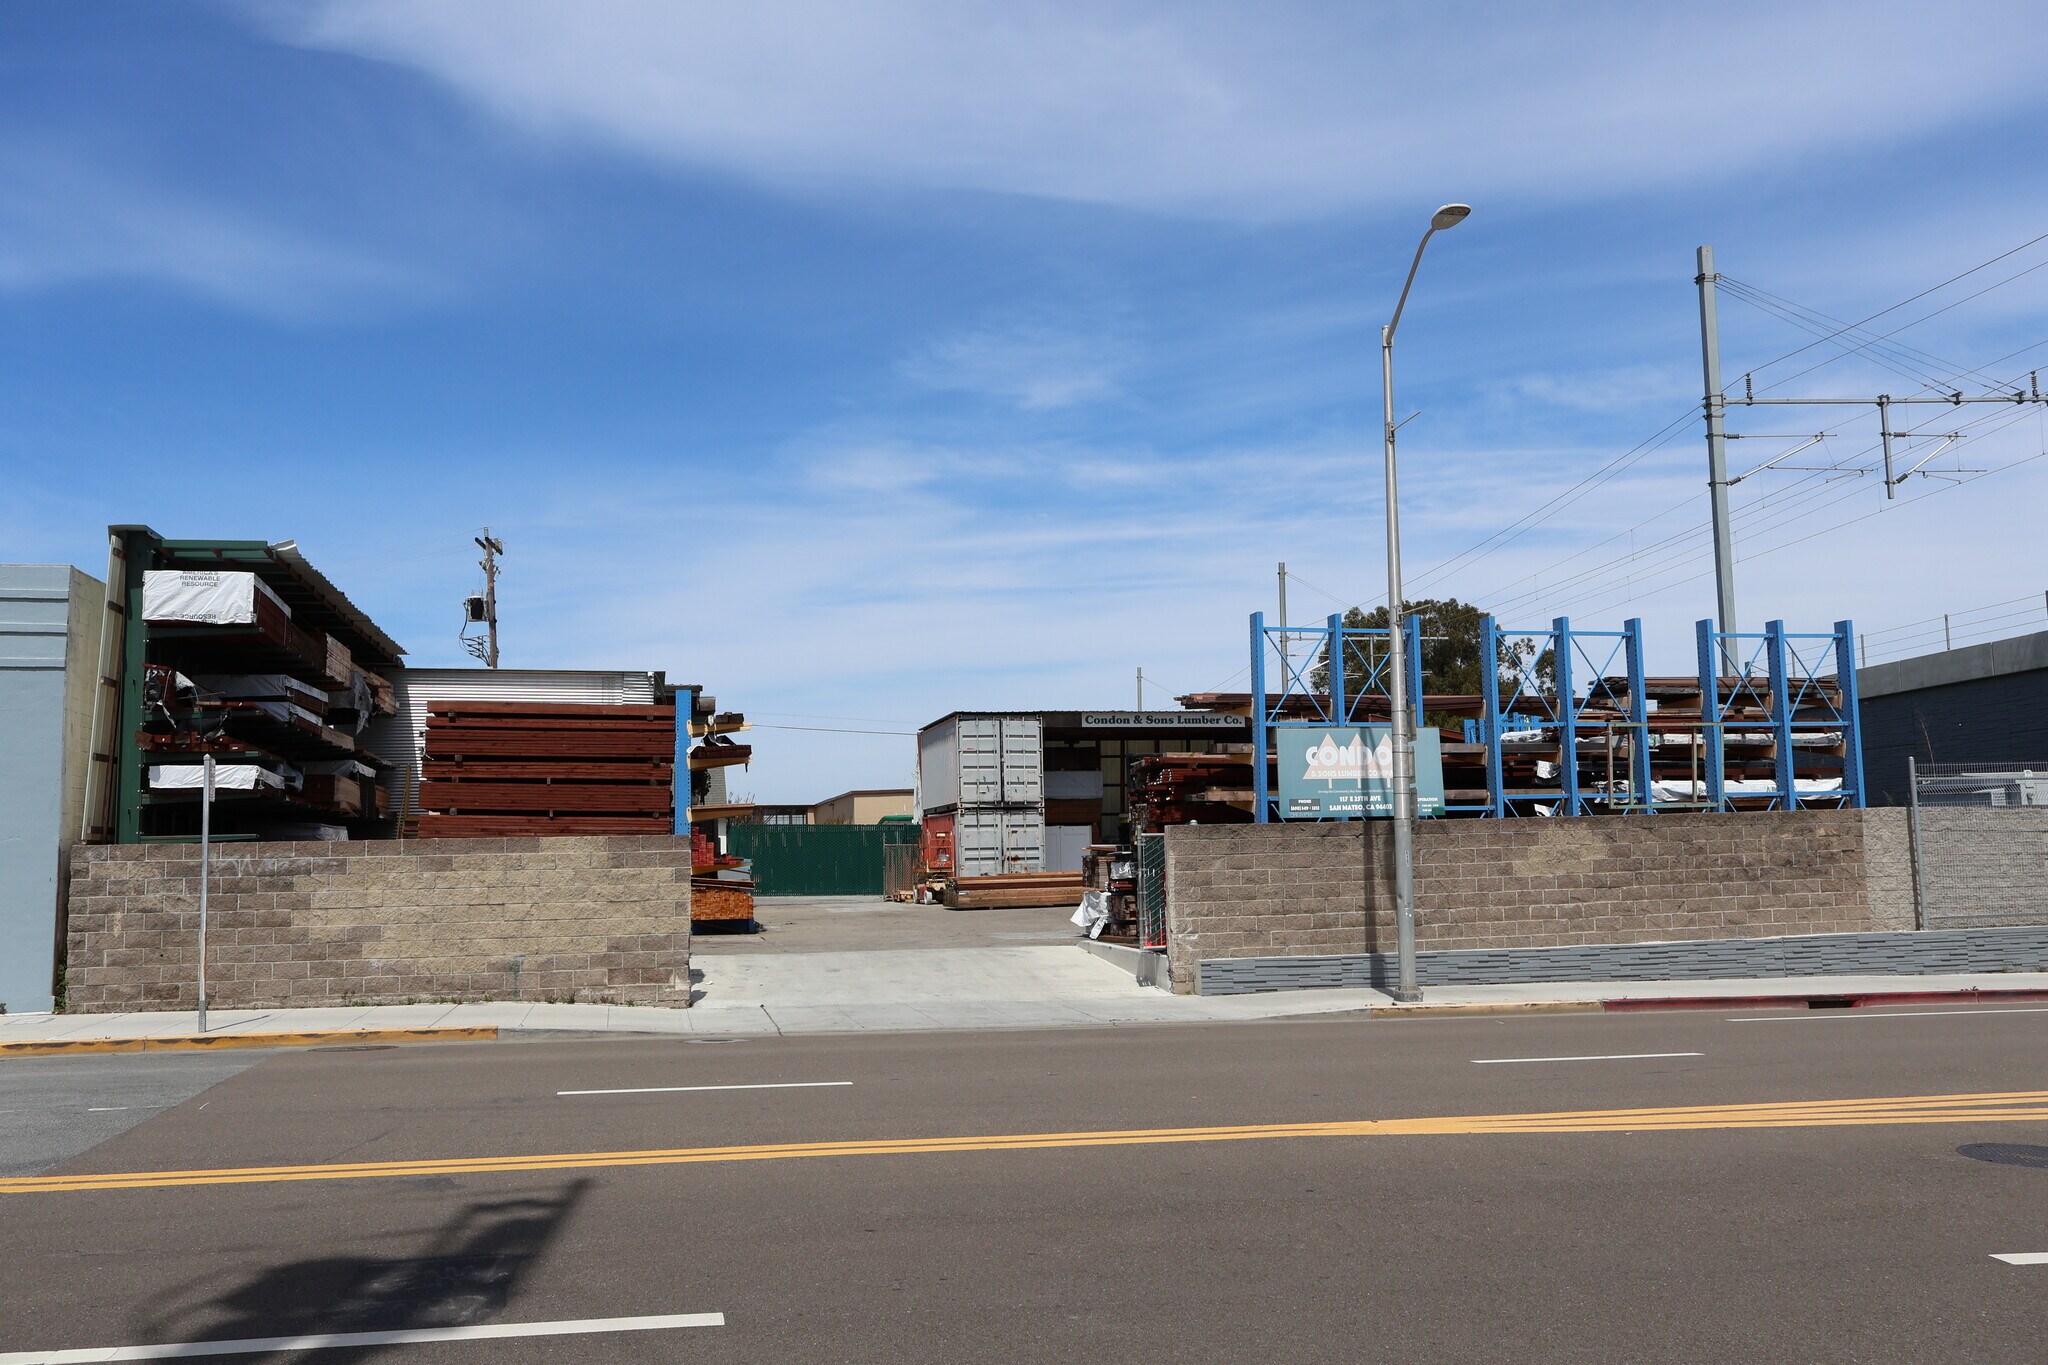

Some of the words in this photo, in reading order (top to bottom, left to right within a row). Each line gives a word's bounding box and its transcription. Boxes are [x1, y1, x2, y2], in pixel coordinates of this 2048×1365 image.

[1085, 715, 1130, 724] Condon
[1133, 715, 1143, 724] &
[1146, 715, 1174, 724] Sons
[1177, 715, 1221, 724] Lumber
[1224, 715, 1242, 724] Co.
[1305, 746, 1393, 765] CONDO
